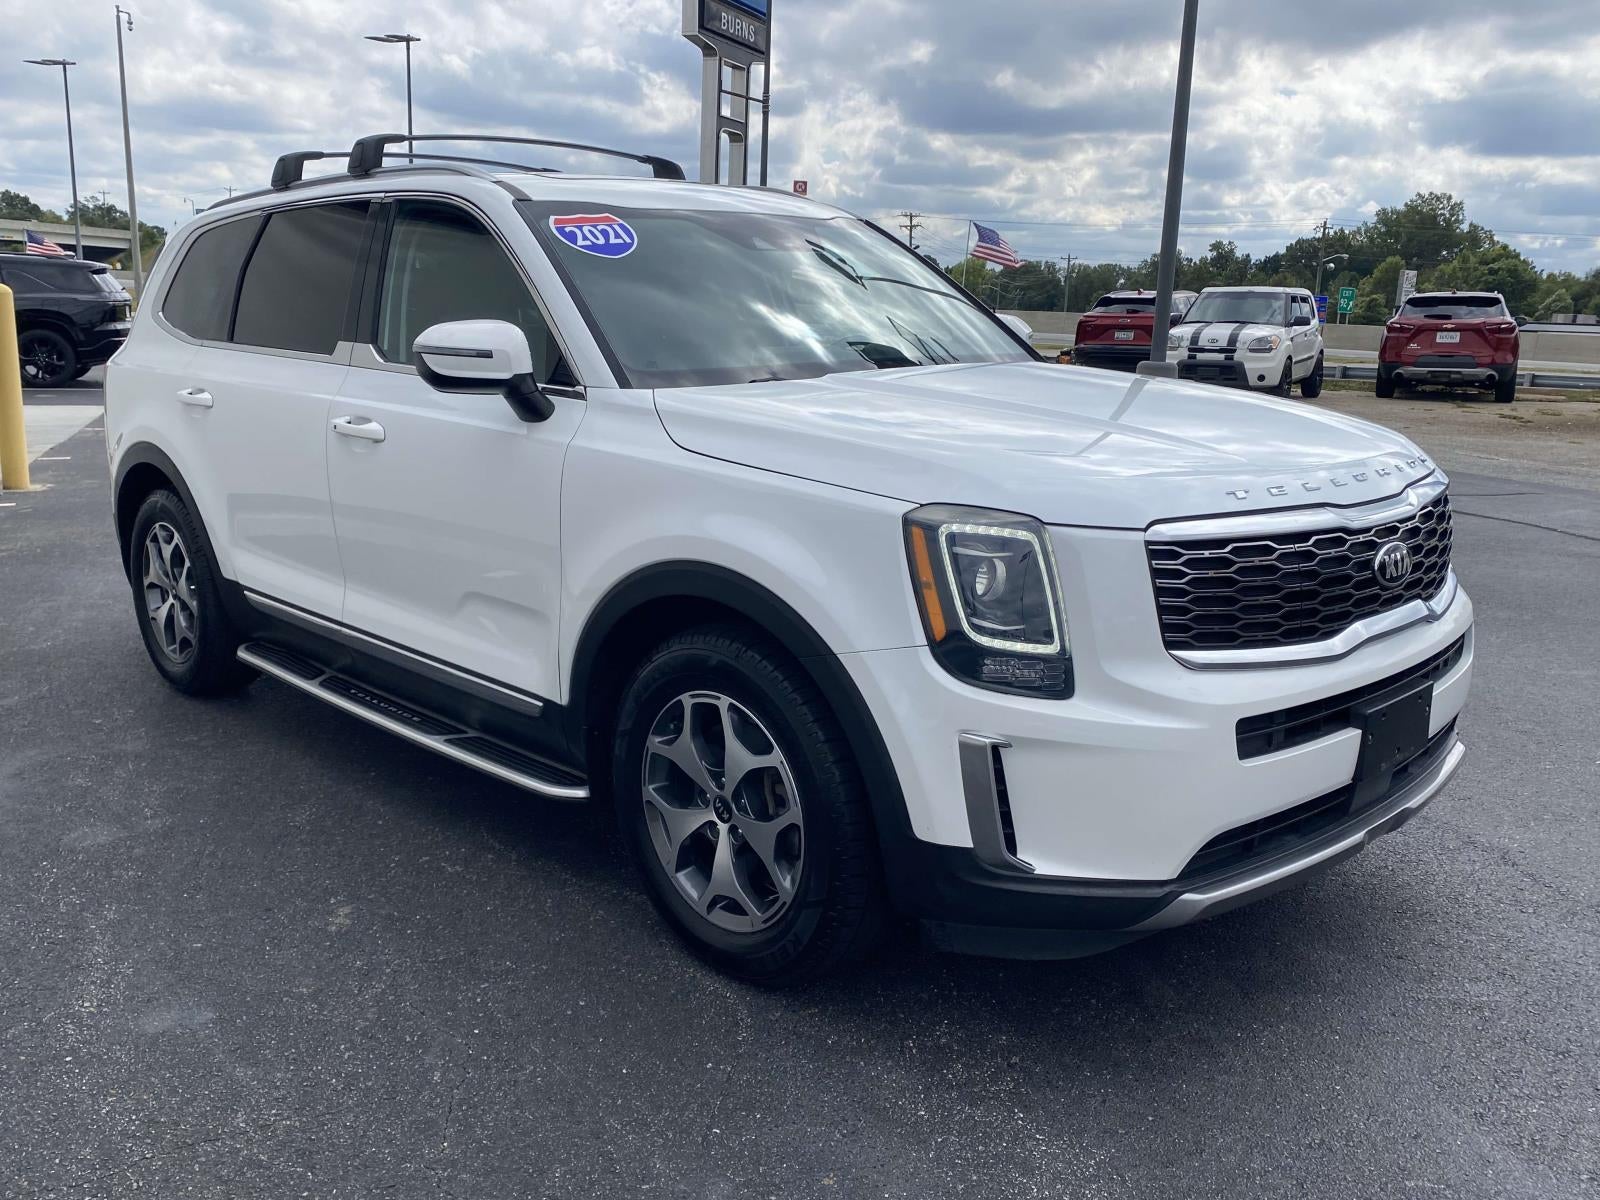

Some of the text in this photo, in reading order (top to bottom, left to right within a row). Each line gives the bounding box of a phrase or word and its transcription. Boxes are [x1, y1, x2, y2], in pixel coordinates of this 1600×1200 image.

[721, 12, 755, 42] BURNS
[564, 224, 632, 246] 2021
[1384, 549, 1410, 579] KIA
